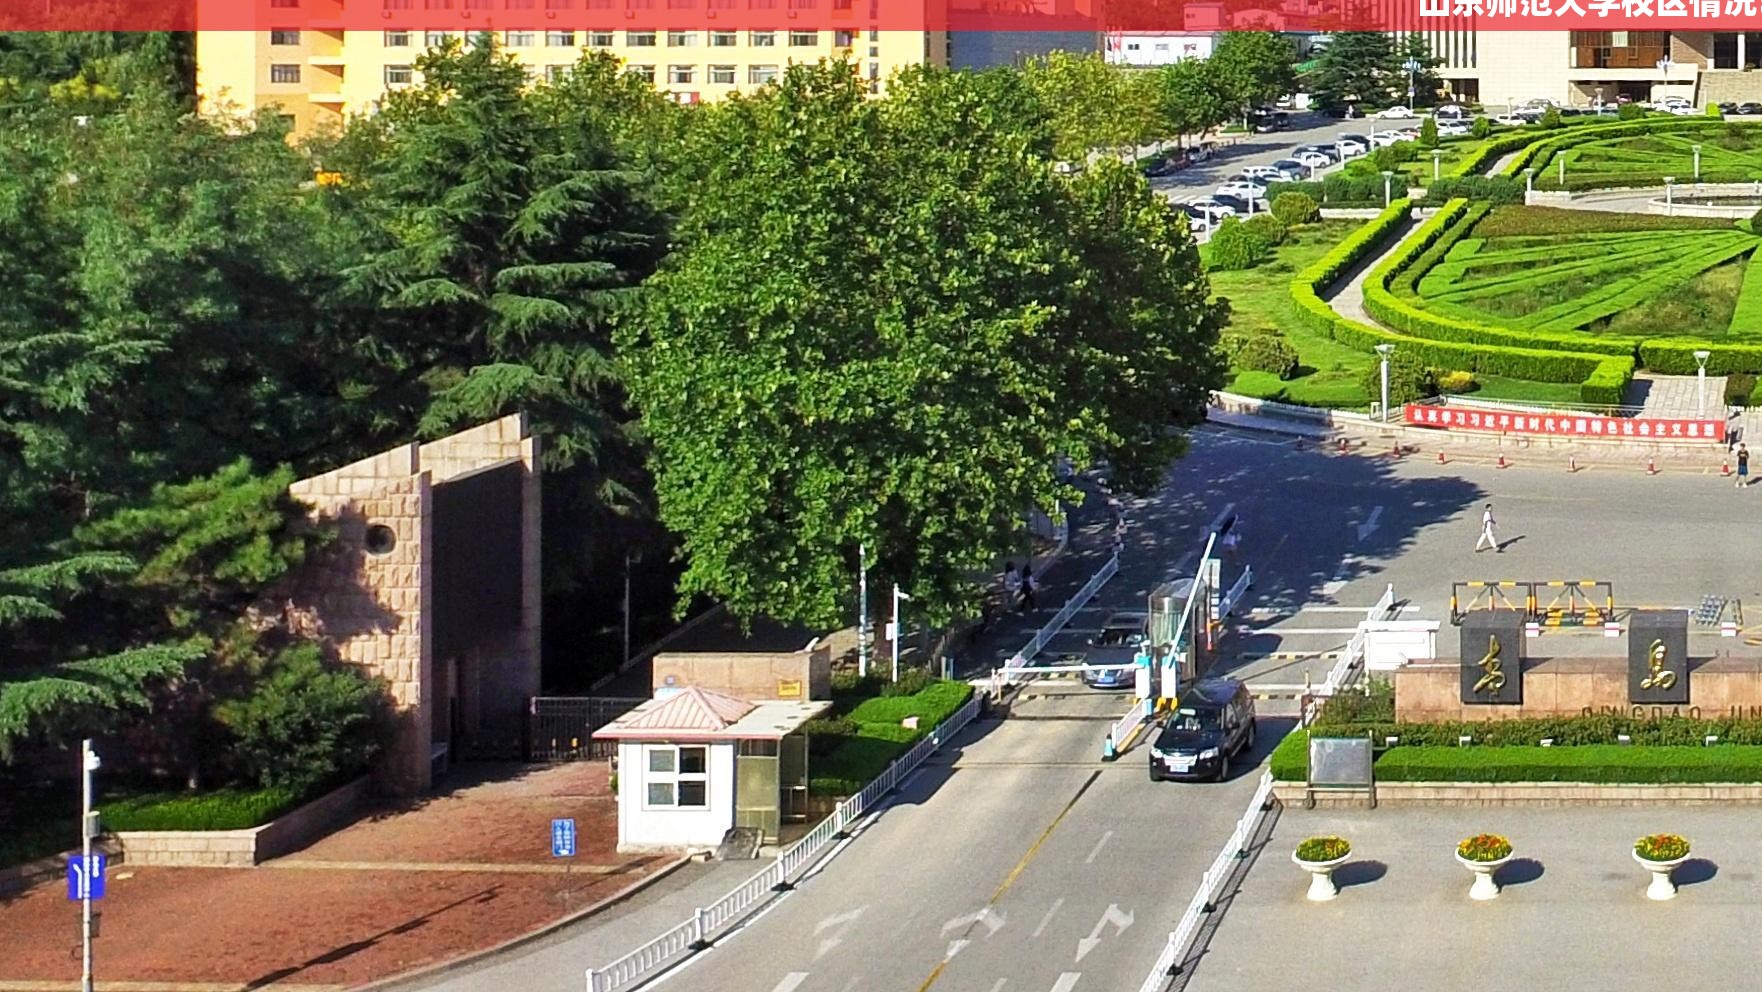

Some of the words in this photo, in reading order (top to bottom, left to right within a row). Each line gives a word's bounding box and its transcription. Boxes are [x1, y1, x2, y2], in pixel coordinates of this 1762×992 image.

[1413, 408, 1715, 437] 认真学习习近平新时代中国特色社会主义思想
